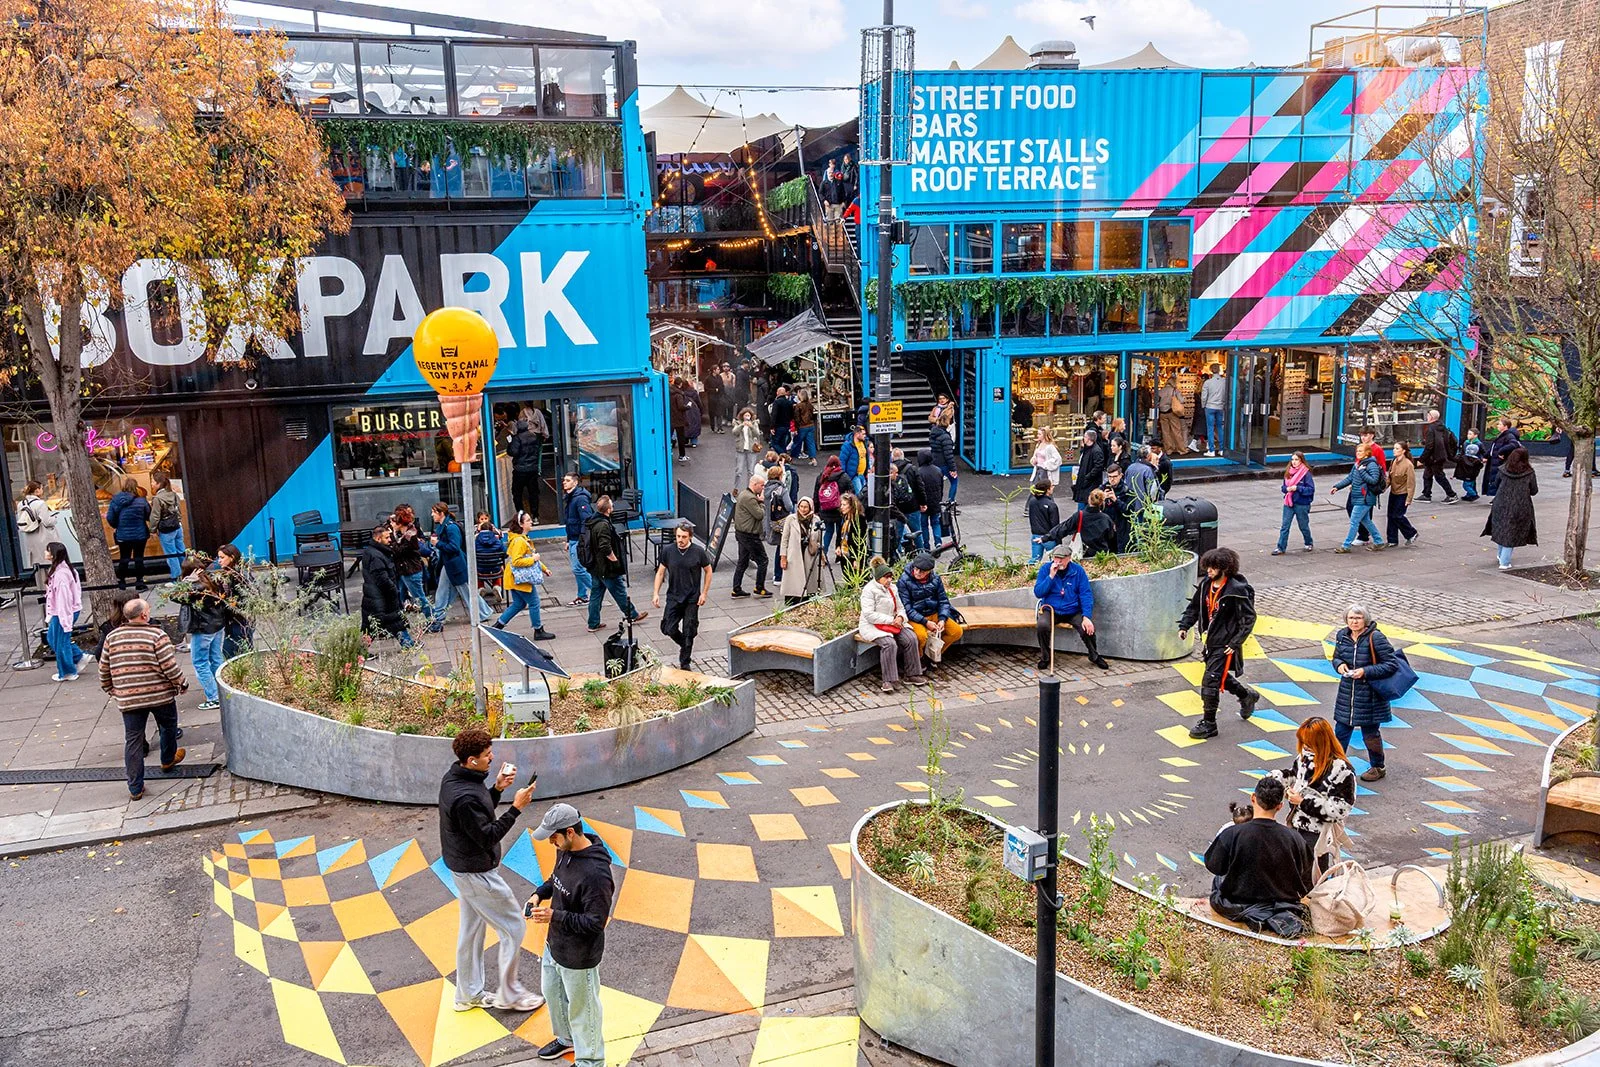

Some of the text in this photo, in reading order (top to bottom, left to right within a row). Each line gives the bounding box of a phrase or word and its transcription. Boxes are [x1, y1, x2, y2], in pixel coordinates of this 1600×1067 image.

[912, 85, 1076, 111] STREET FOOD
[911, 113, 978, 138] BARS
[911, 138, 1110, 164] MARKET STALLS
[911, 165, 1097, 192] ROOF TERRACE
[36, 250, 598, 369] BOXPARK
[429, 370, 478, 380] TOW PATH
[459, 359, 489, 371] CANAL
[1019, 385, 1058, 395] HAND-MADE
